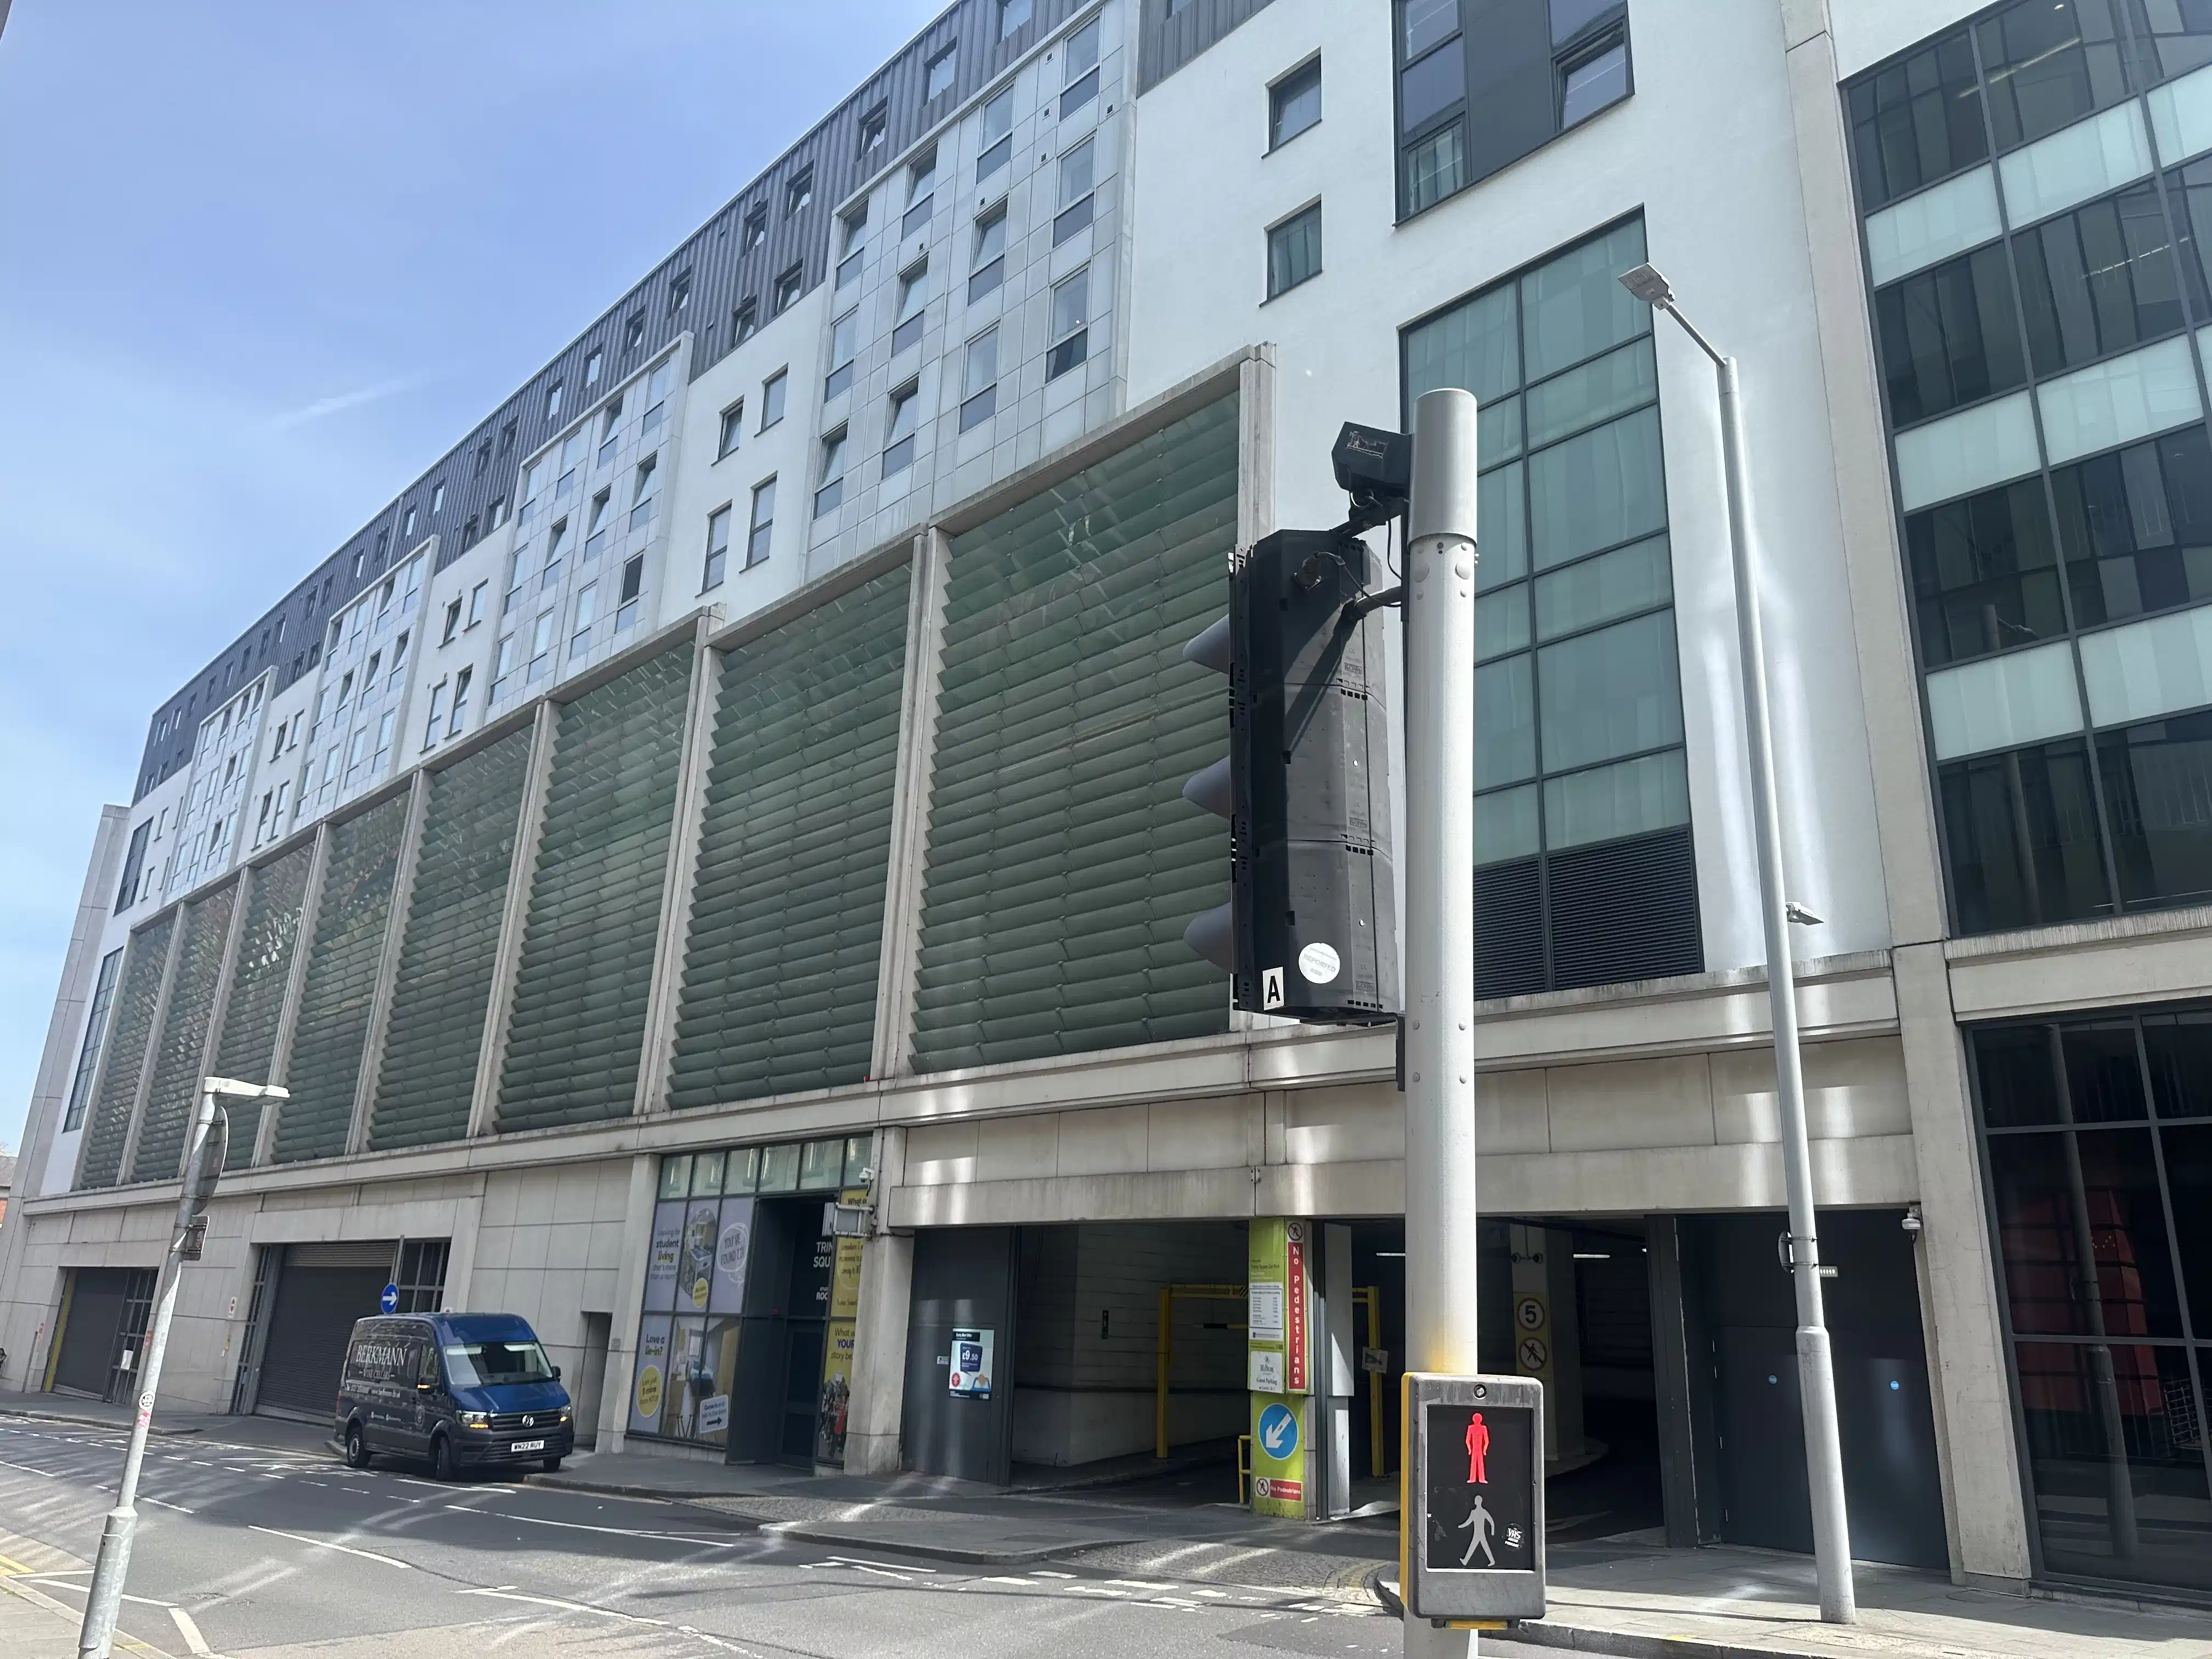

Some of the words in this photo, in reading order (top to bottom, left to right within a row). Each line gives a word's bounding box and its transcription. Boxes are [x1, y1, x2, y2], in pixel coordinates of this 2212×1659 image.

[1267, 975, 1281, 1004] A
[656, 1238, 679, 1248] student
[816, 1242, 833, 1253] TRIN
[813, 1256, 831, 1268] SQU
[1525, 1305, 1537, 1324] 5
[835, 1328, 849, 1337] What
[646, 1333, 659, 1344] Love
[356, 1344, 408, 1366] BERKMANN
[831, 1352, 845, 1363] story
[962, 1350, 978, 1361] £9.50
[1277, 1486, 1301, 1494] Pedestrians
[1506, 1527, 1522, 1540] VHS
